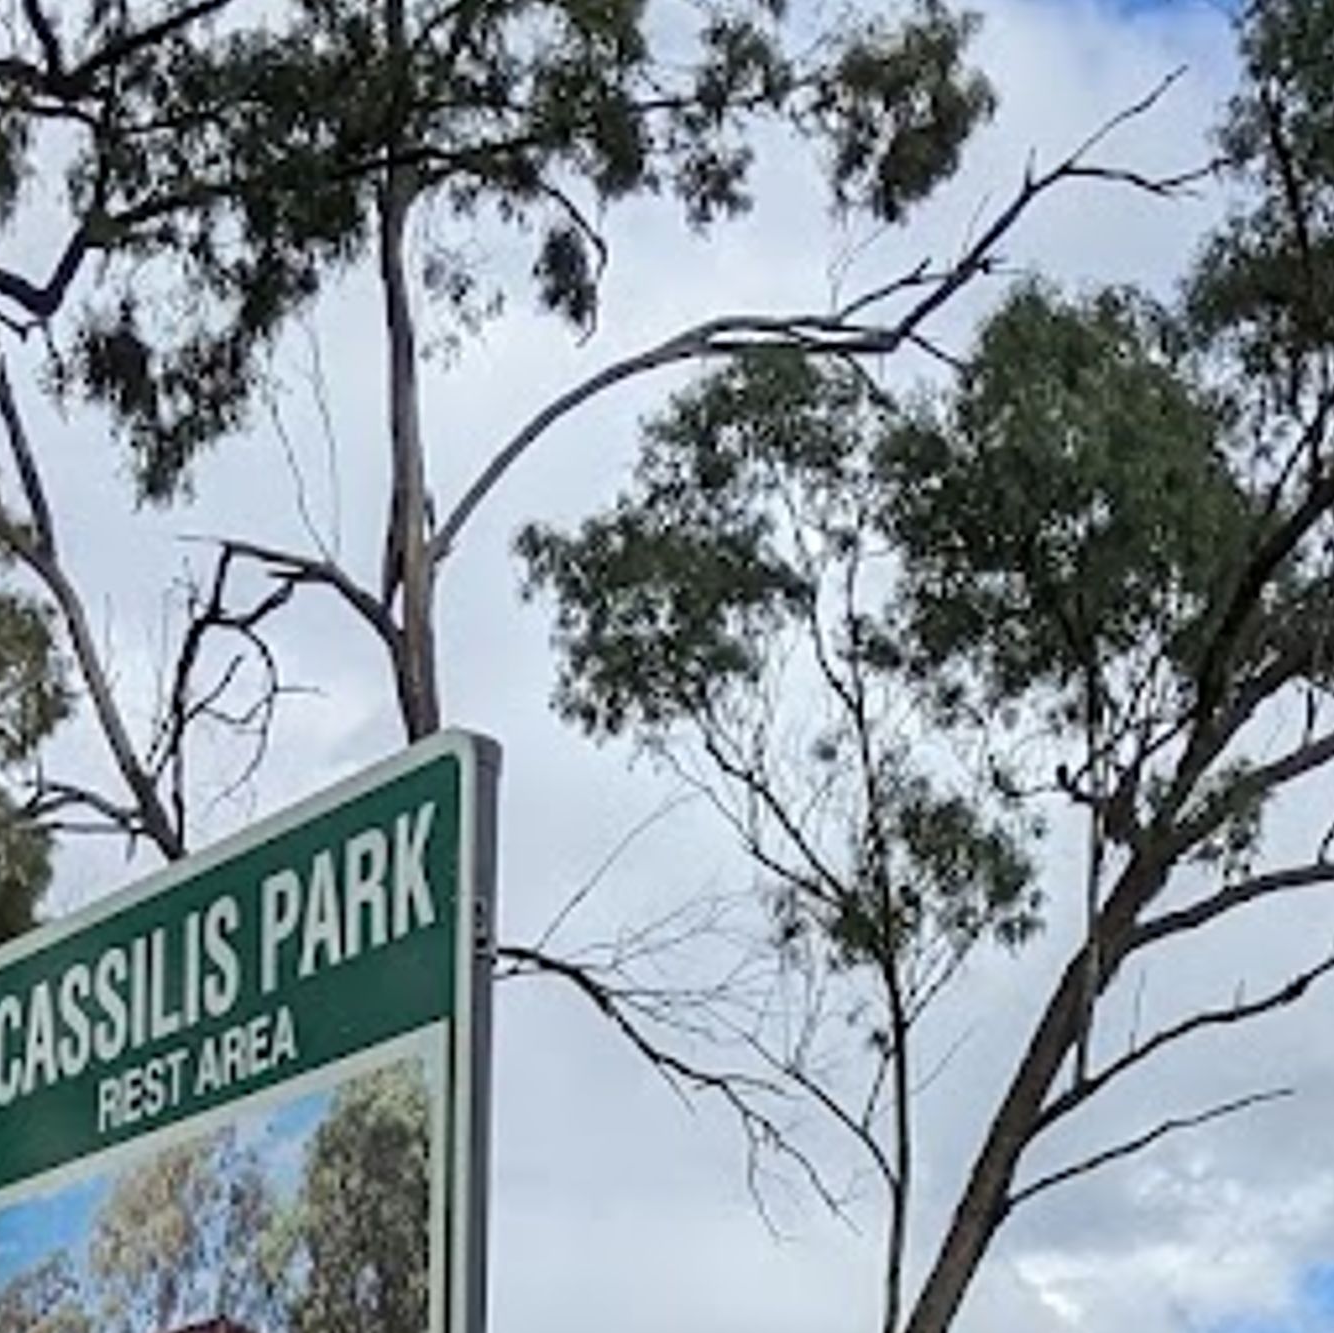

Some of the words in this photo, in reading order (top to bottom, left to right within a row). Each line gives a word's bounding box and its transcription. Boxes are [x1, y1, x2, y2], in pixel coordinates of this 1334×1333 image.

[260, 801, 436, 992] PARK
[97, 1046, 189, 1133] REST
[193, 1005, 297, 1095] AREA
